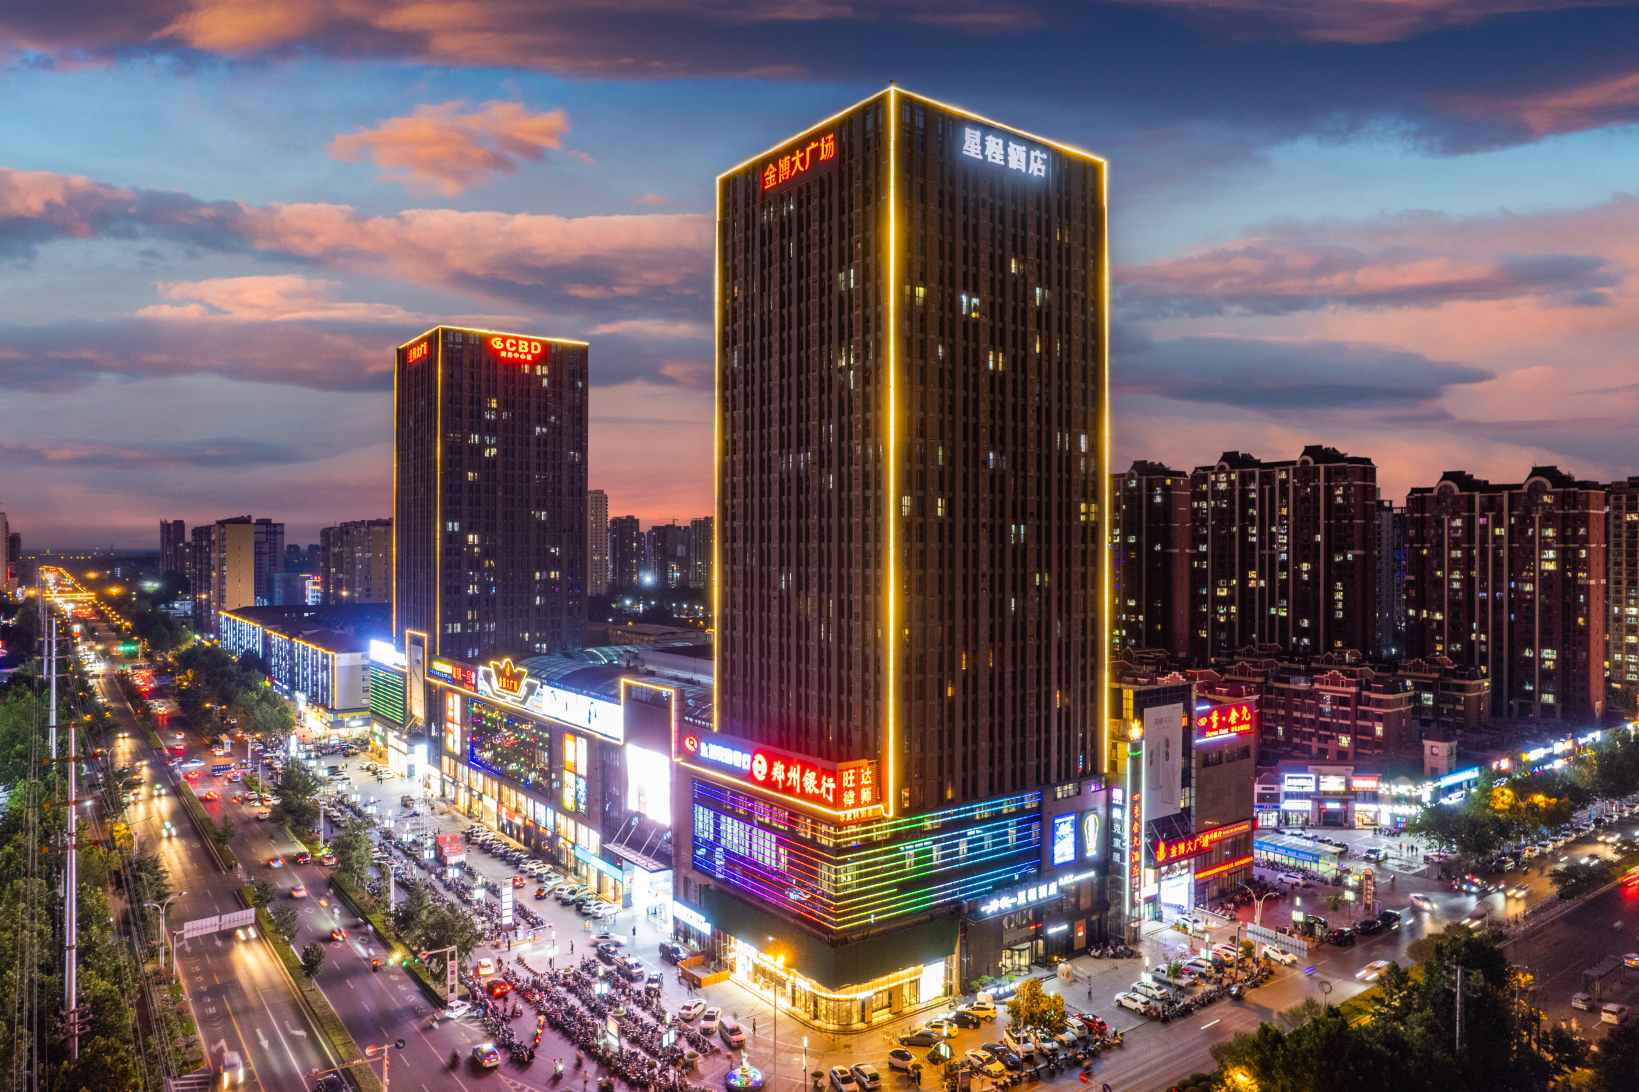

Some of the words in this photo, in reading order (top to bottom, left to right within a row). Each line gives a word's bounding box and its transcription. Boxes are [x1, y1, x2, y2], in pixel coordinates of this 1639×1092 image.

[764, 132, 835, 190] 金博大广场
[962, 127, 1047, 178] 星程酒店
[771, 761, 836, 803] 郑州银行
[842, 767, 872, 788] 旺达
[843, 786, 872, 807] 律师
[1170, 834, 1209, 858] 金博大广场
